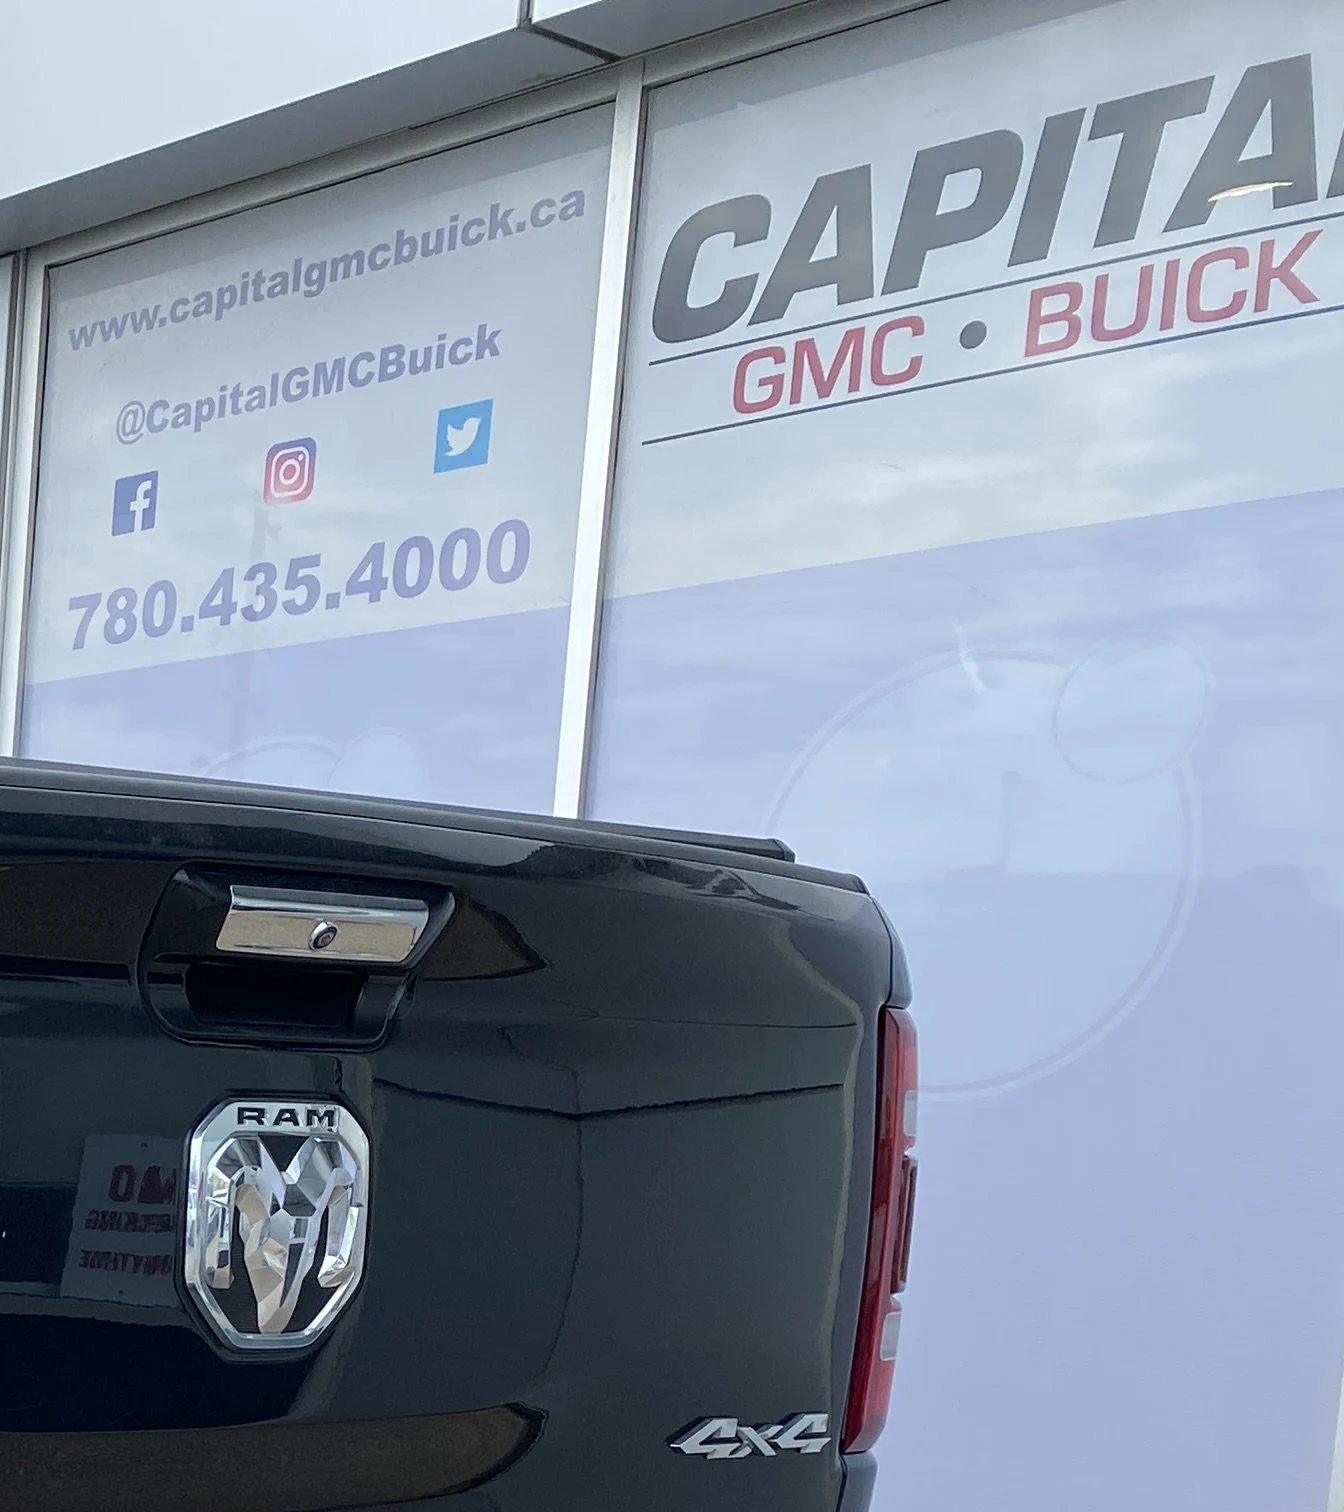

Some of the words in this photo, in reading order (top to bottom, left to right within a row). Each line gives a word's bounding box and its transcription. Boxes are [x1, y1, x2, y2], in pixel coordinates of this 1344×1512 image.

[69, 189, 586, 351] www.capitalgmcbuick.ca
[652, 53, 1344, 344] CAPITA
[115, 324, 502, 445] @CapitalGMCBuick
[731, 316, 925, 415] GMC
[1024, 229, 1324, 358] BUICK
[67, 519, 531, 651] 780.435.4000
[237, 1106, 336, 1128] RAM
